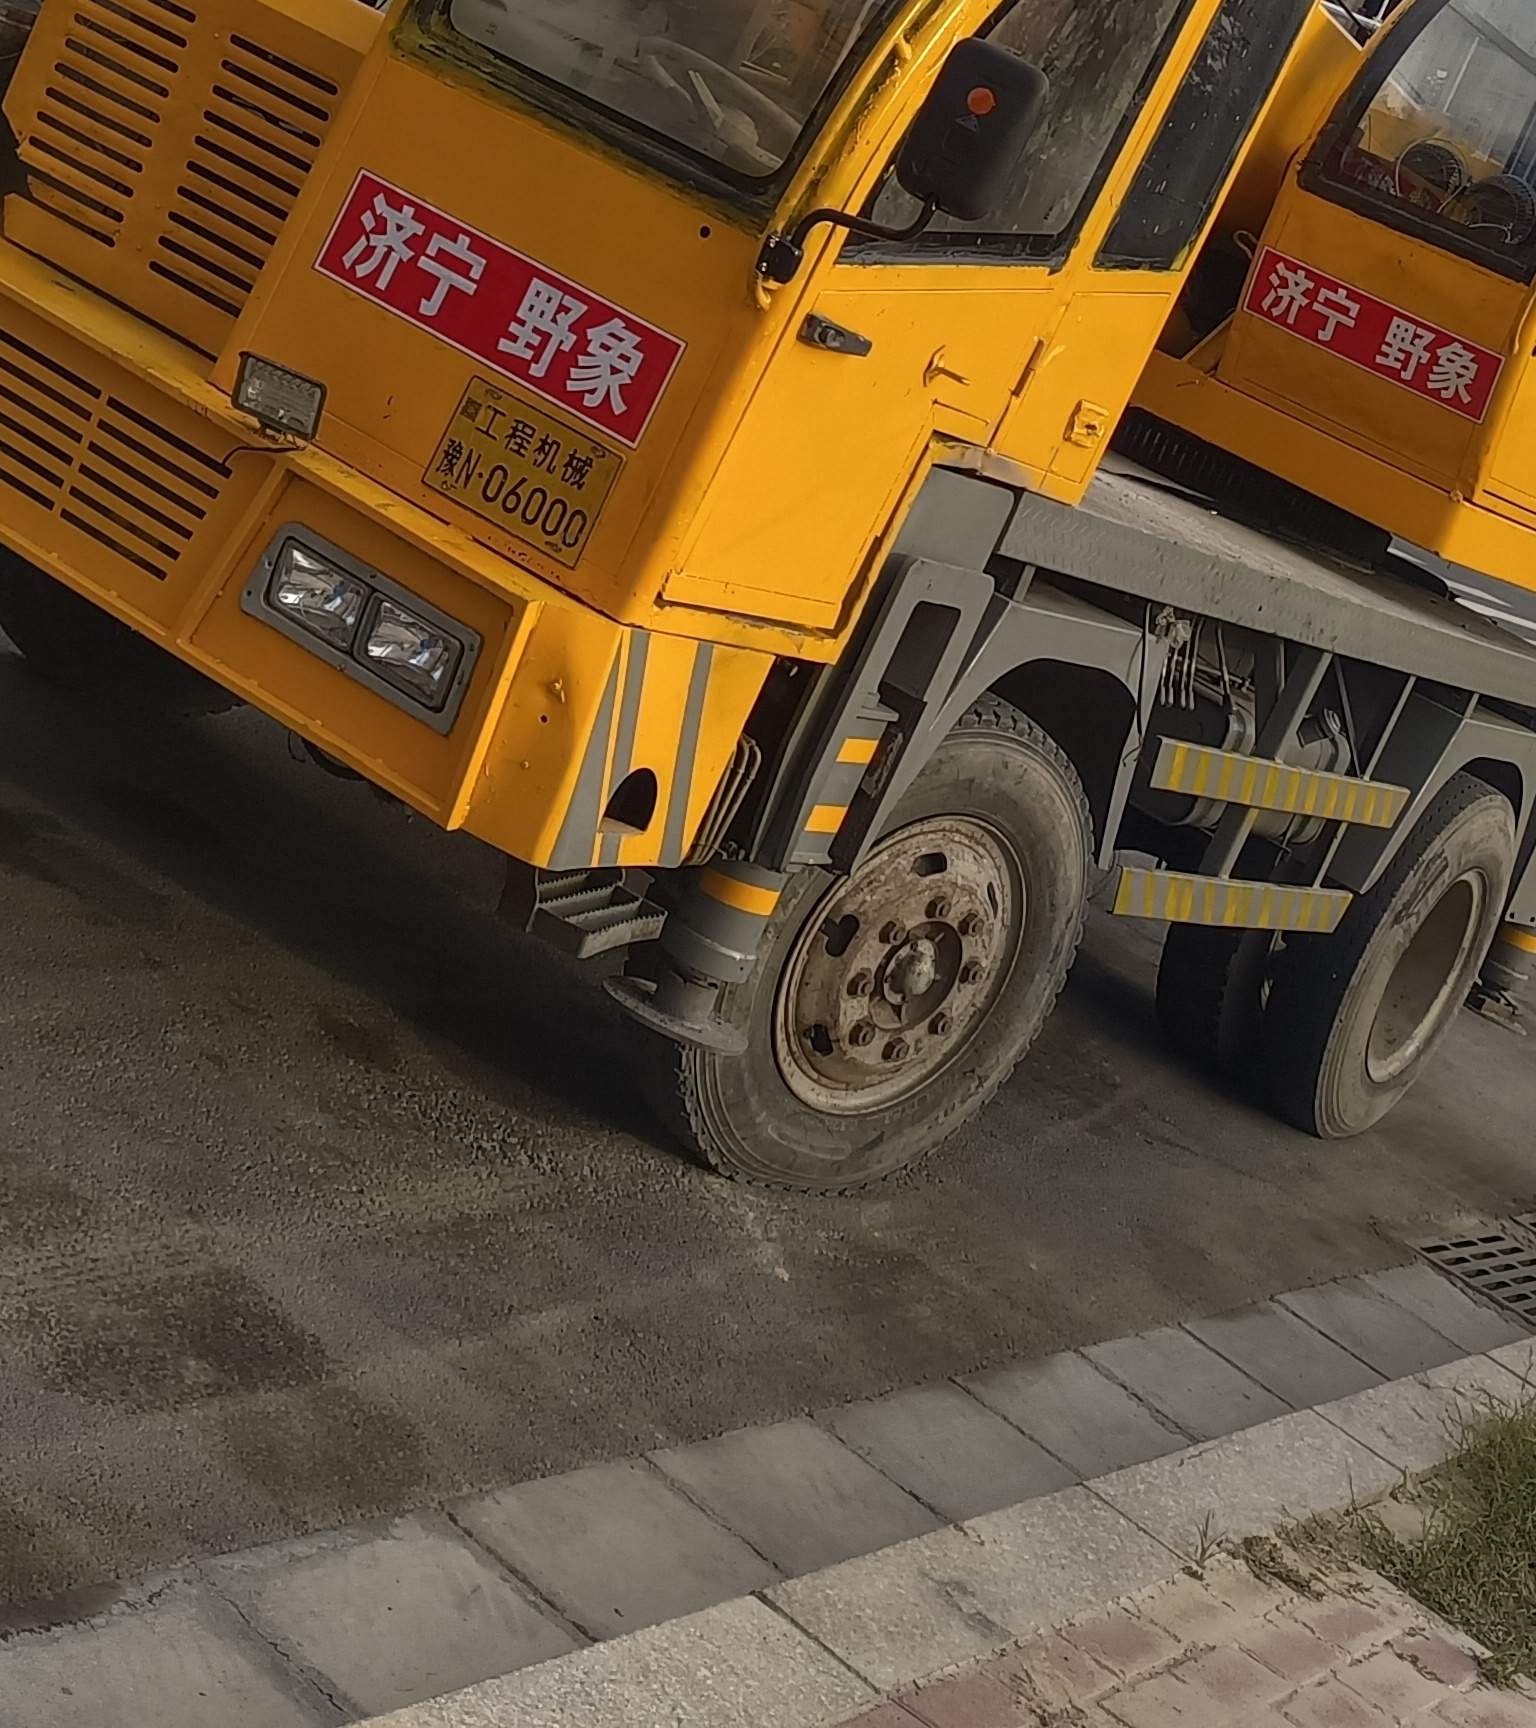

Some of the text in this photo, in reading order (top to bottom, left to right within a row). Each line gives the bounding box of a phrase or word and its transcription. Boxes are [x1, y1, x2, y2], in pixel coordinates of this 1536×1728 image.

[343, 194, 644, 415] 济宁 野象
[1262, 262, 1480, 404] 济宁 野象
[476, 403, 593, 490] 工程机械
